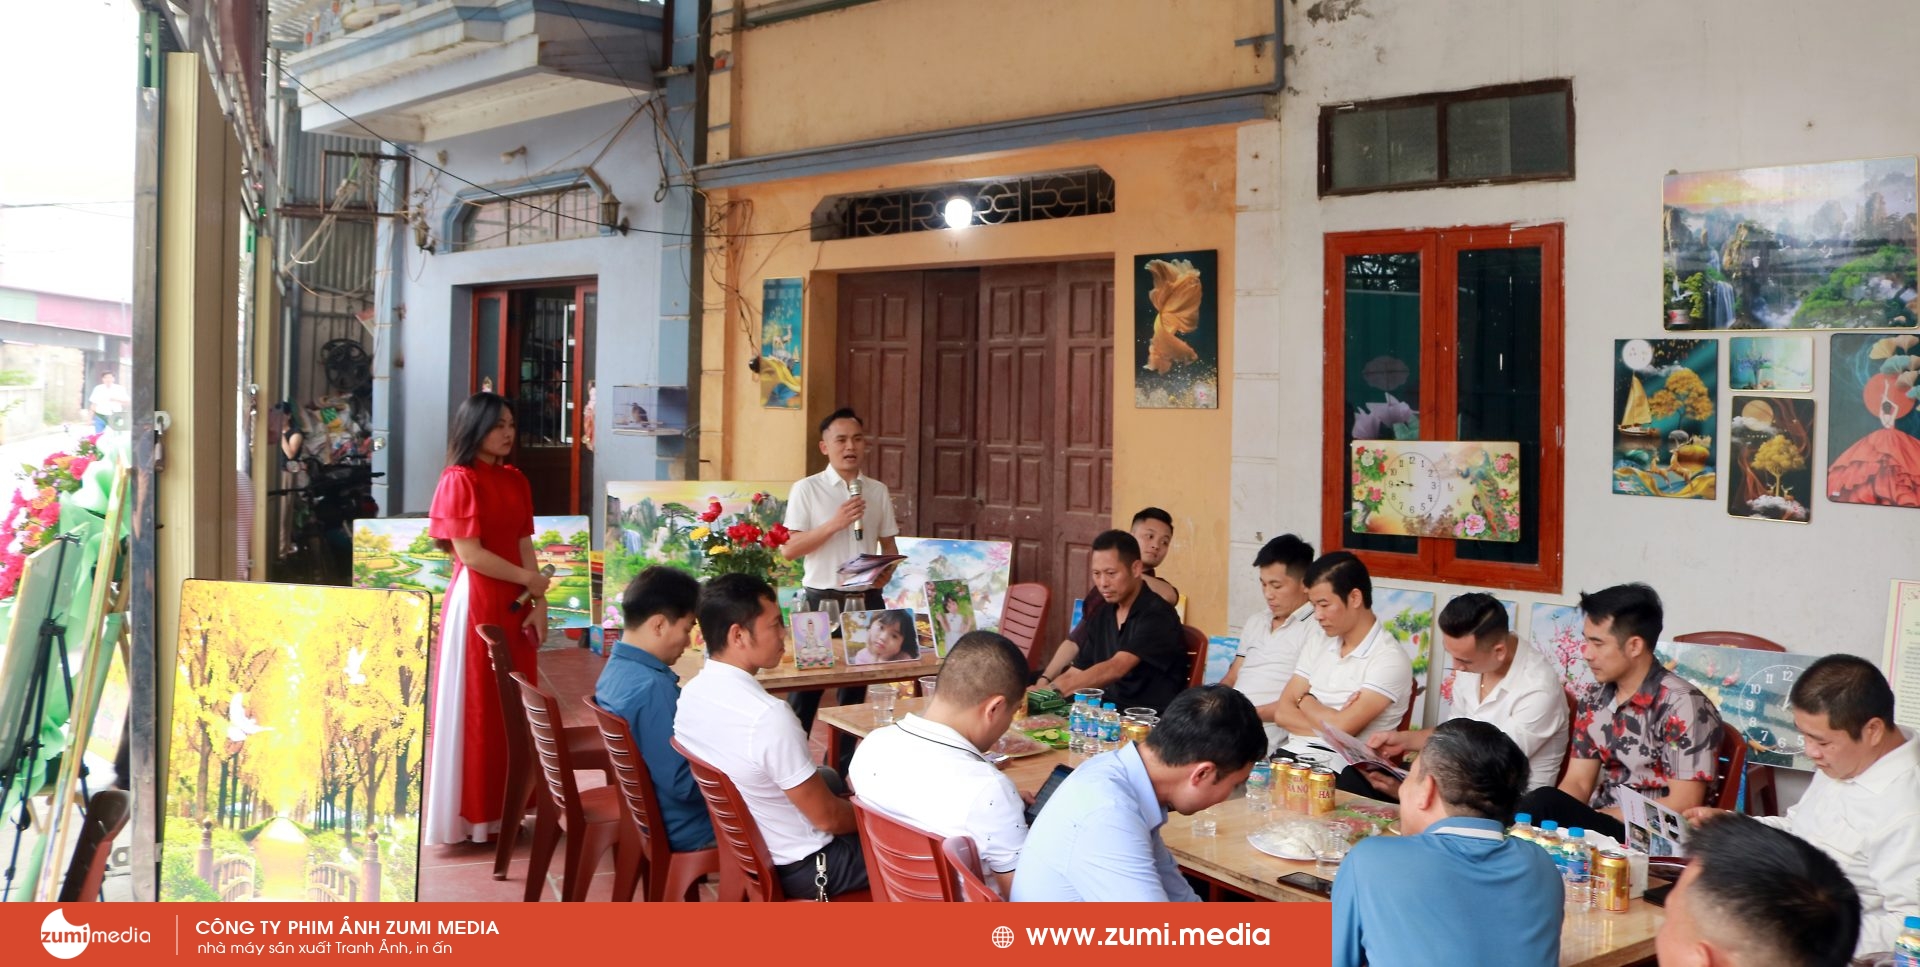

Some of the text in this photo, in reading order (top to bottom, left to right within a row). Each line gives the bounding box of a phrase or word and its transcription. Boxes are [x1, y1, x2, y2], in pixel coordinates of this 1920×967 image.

[1765, 673, 1774, 684] 11
[1782, 670, 1793, 682] 12
[1750, 683, 1761, 695] 10
[1745, 699, 1754, 712] 9
[1748, 716, 1757, 728] 8
[1760, 730, 1769, 742] 7
[1797, 734, 1805, 747] 5
[1777, 737, 1787, 749] 6
